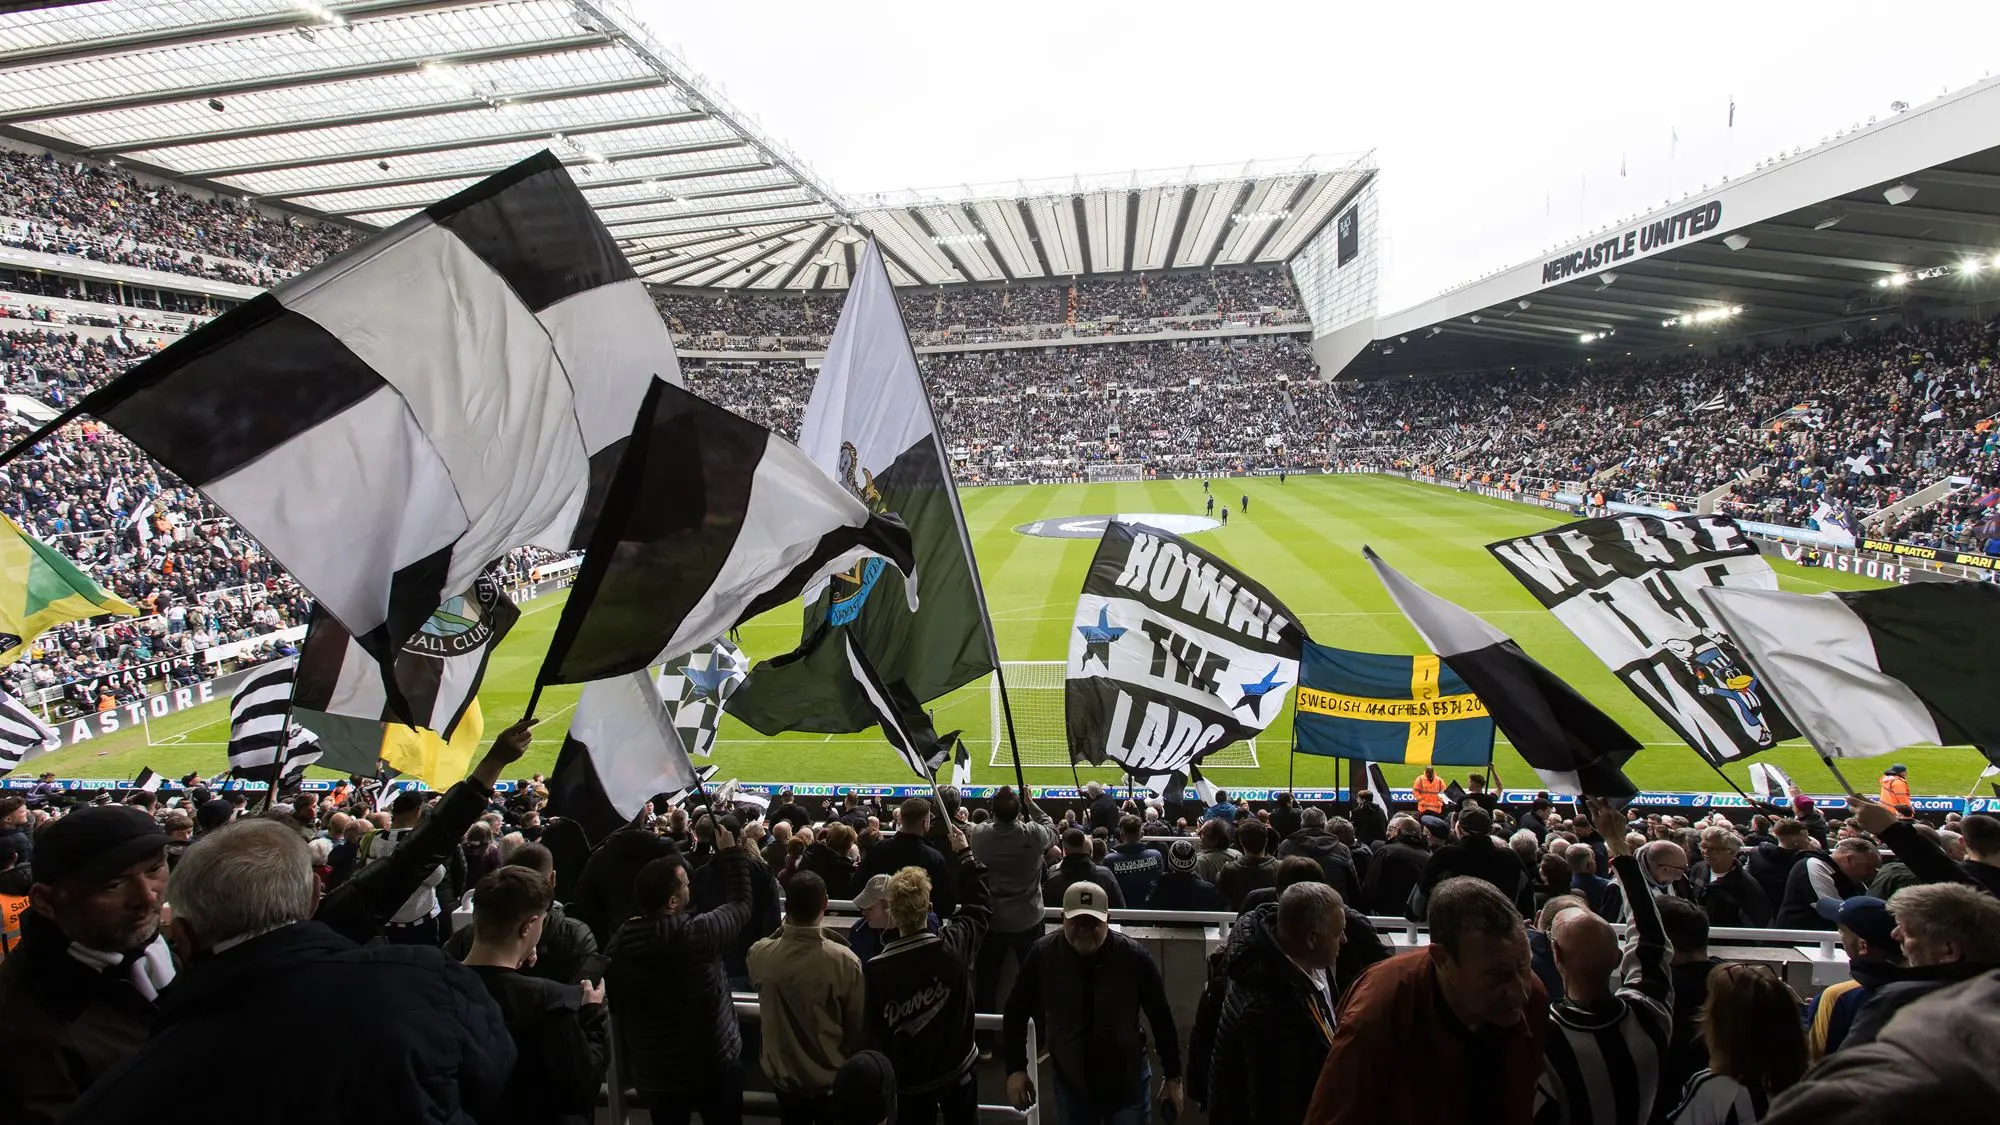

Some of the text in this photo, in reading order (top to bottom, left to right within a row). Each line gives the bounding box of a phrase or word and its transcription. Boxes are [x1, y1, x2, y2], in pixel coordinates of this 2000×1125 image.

[1542, 200, 1722, 284] NEWCASTLE UNITED
[1486, 487, 1513, 501] CASTORE
[1495, 529, 1617, 594] WE
[1869, 541, 1936, 559] PARI MATCH
[1962, 555, 1992, 568] PARI
[1816, 551, 1911, 584] ASTORE
[1115, 532, 1290, 645] HOWAY
[453, 622, 489, 651] CLUB
[109, 656, 195, 686] CASTORE
[1141, 618, 1231, 695] THE
[1300, 693, 1361, 713] SWEDISH
[1106, 689, 1226, 771] LADS
[82, 780, 116, 789] NIXON
[793, 786, 834, 795] NIXON
[1229, 790, 1268, 800] IXON
